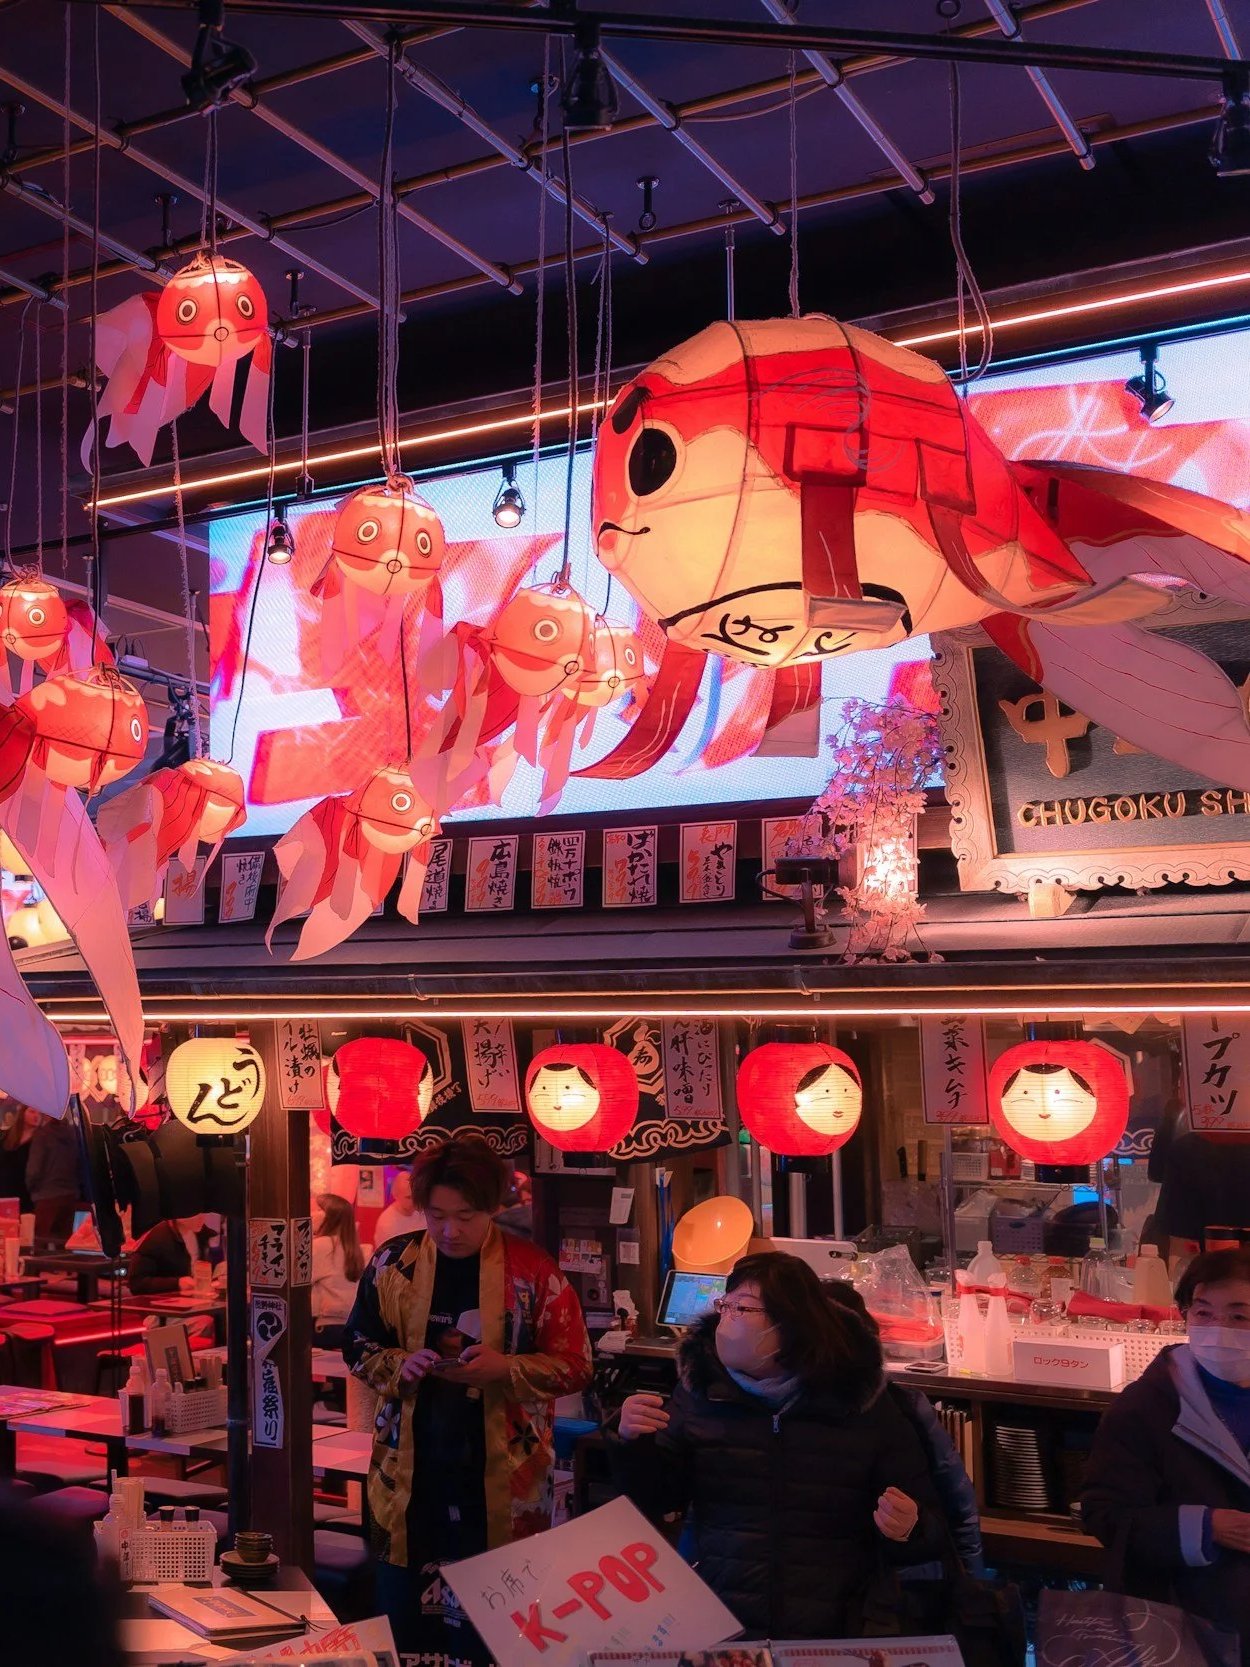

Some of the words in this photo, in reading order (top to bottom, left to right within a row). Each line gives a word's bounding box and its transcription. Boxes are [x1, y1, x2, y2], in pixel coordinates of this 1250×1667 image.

[1017, 792, 1187, 830] CHUGOKU
[187, 1047, 261, 1126] うどん
[510, 1542, 666, 1655] K-POP
